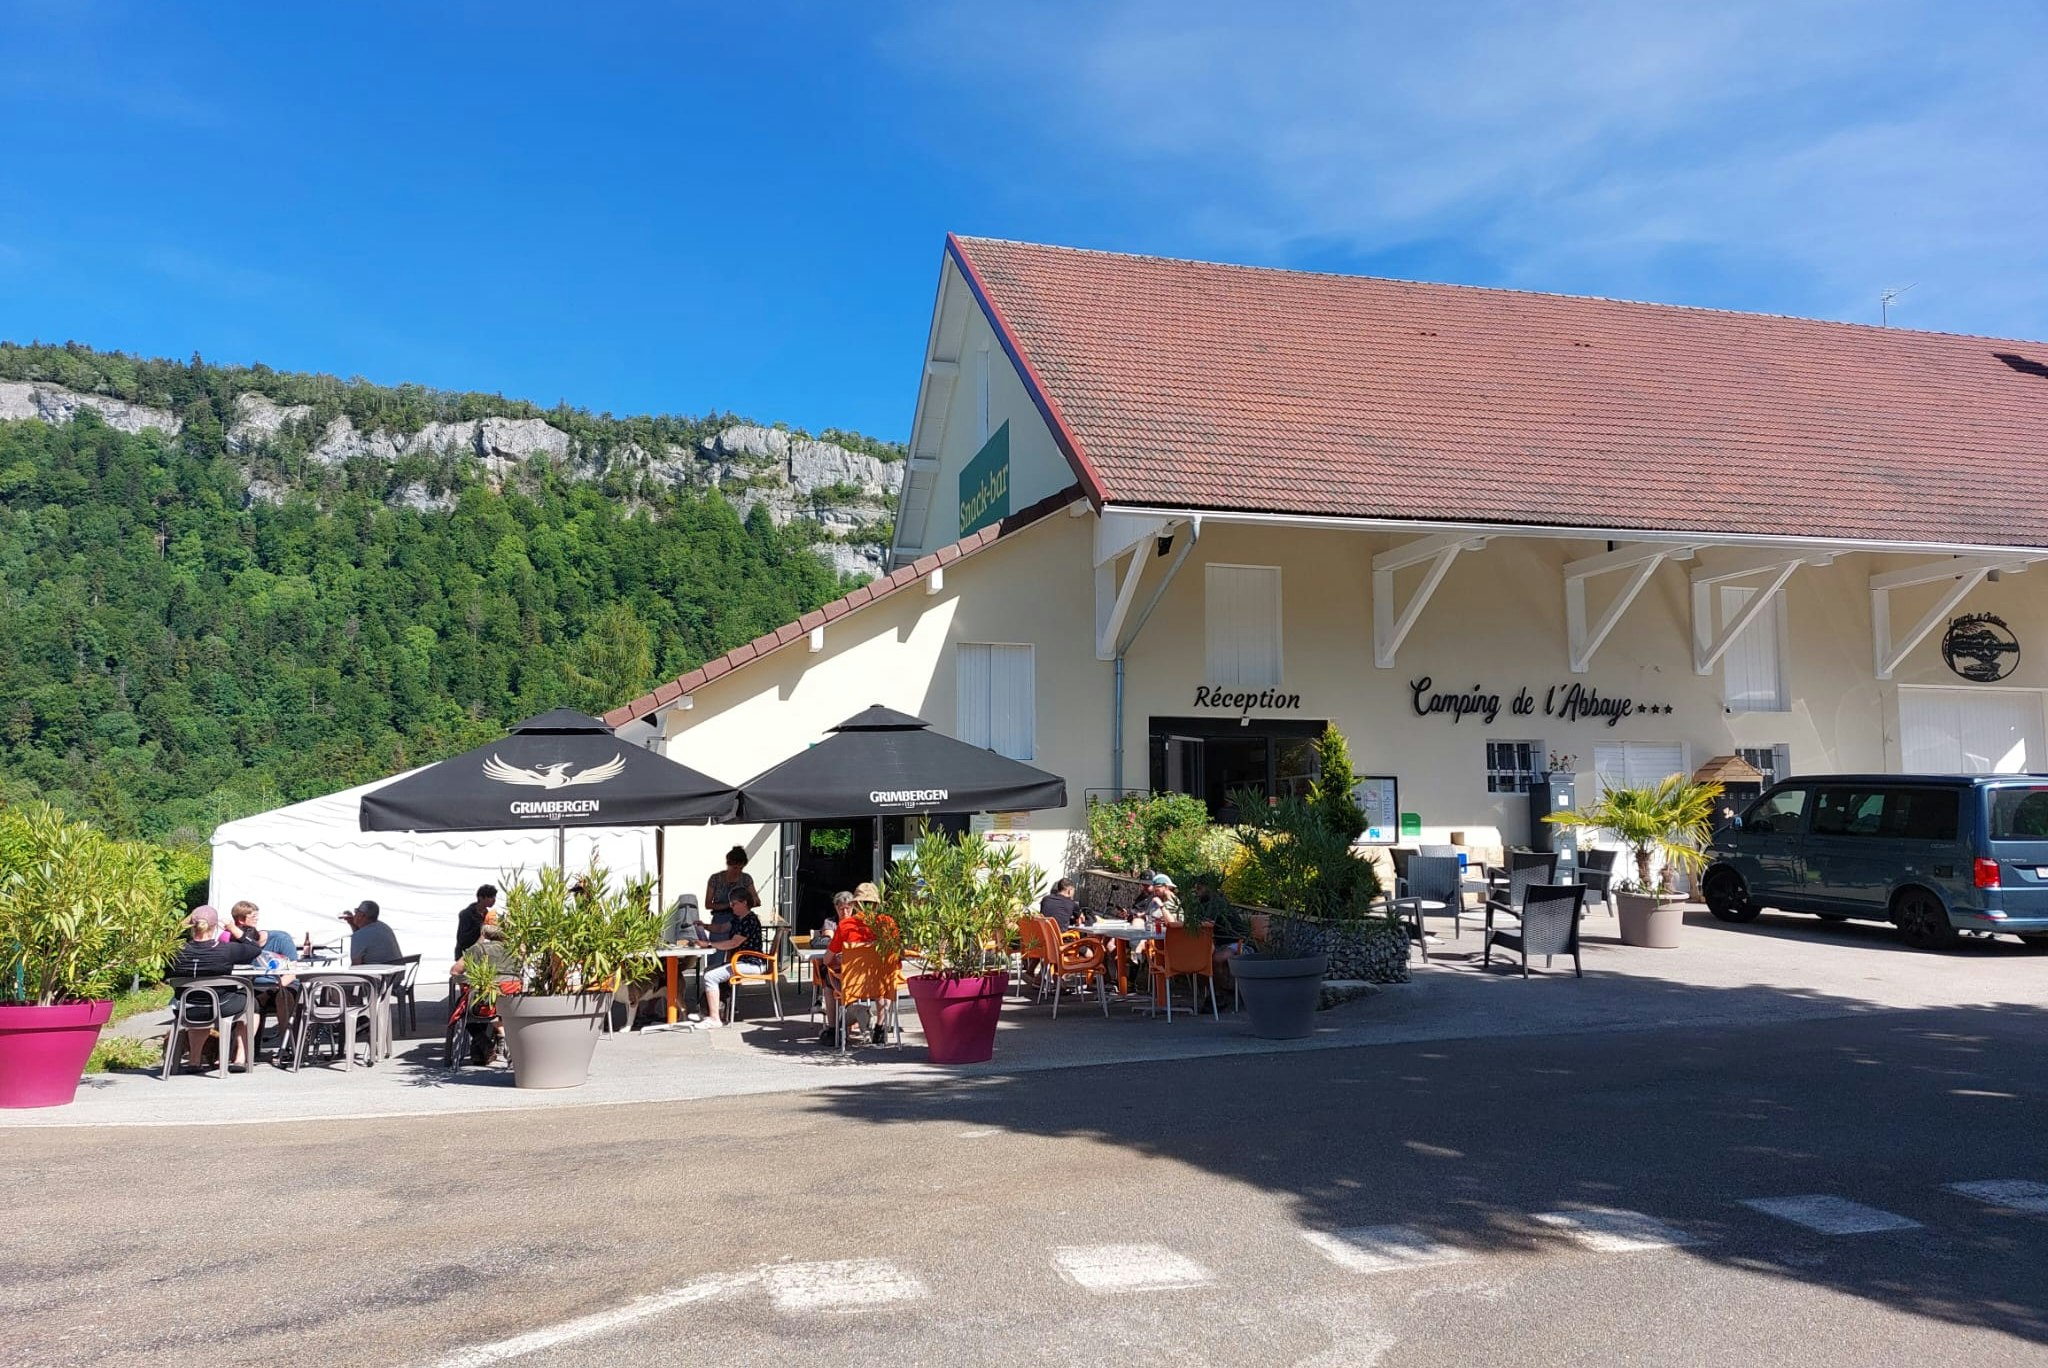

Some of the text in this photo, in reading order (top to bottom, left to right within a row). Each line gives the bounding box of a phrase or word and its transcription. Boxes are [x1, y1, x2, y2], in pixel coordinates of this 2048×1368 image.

[960, 463, 1009, 533] Snack-bar
[1193, 686, 1301, 715] Réception
[1410, 676, 1501, 724] Camping
[1512, 686, 1535, 715] de
[510, 800, 600, 814] GRIMBERGEN
[869, 789, 949, 803] GRIMBERGEN
